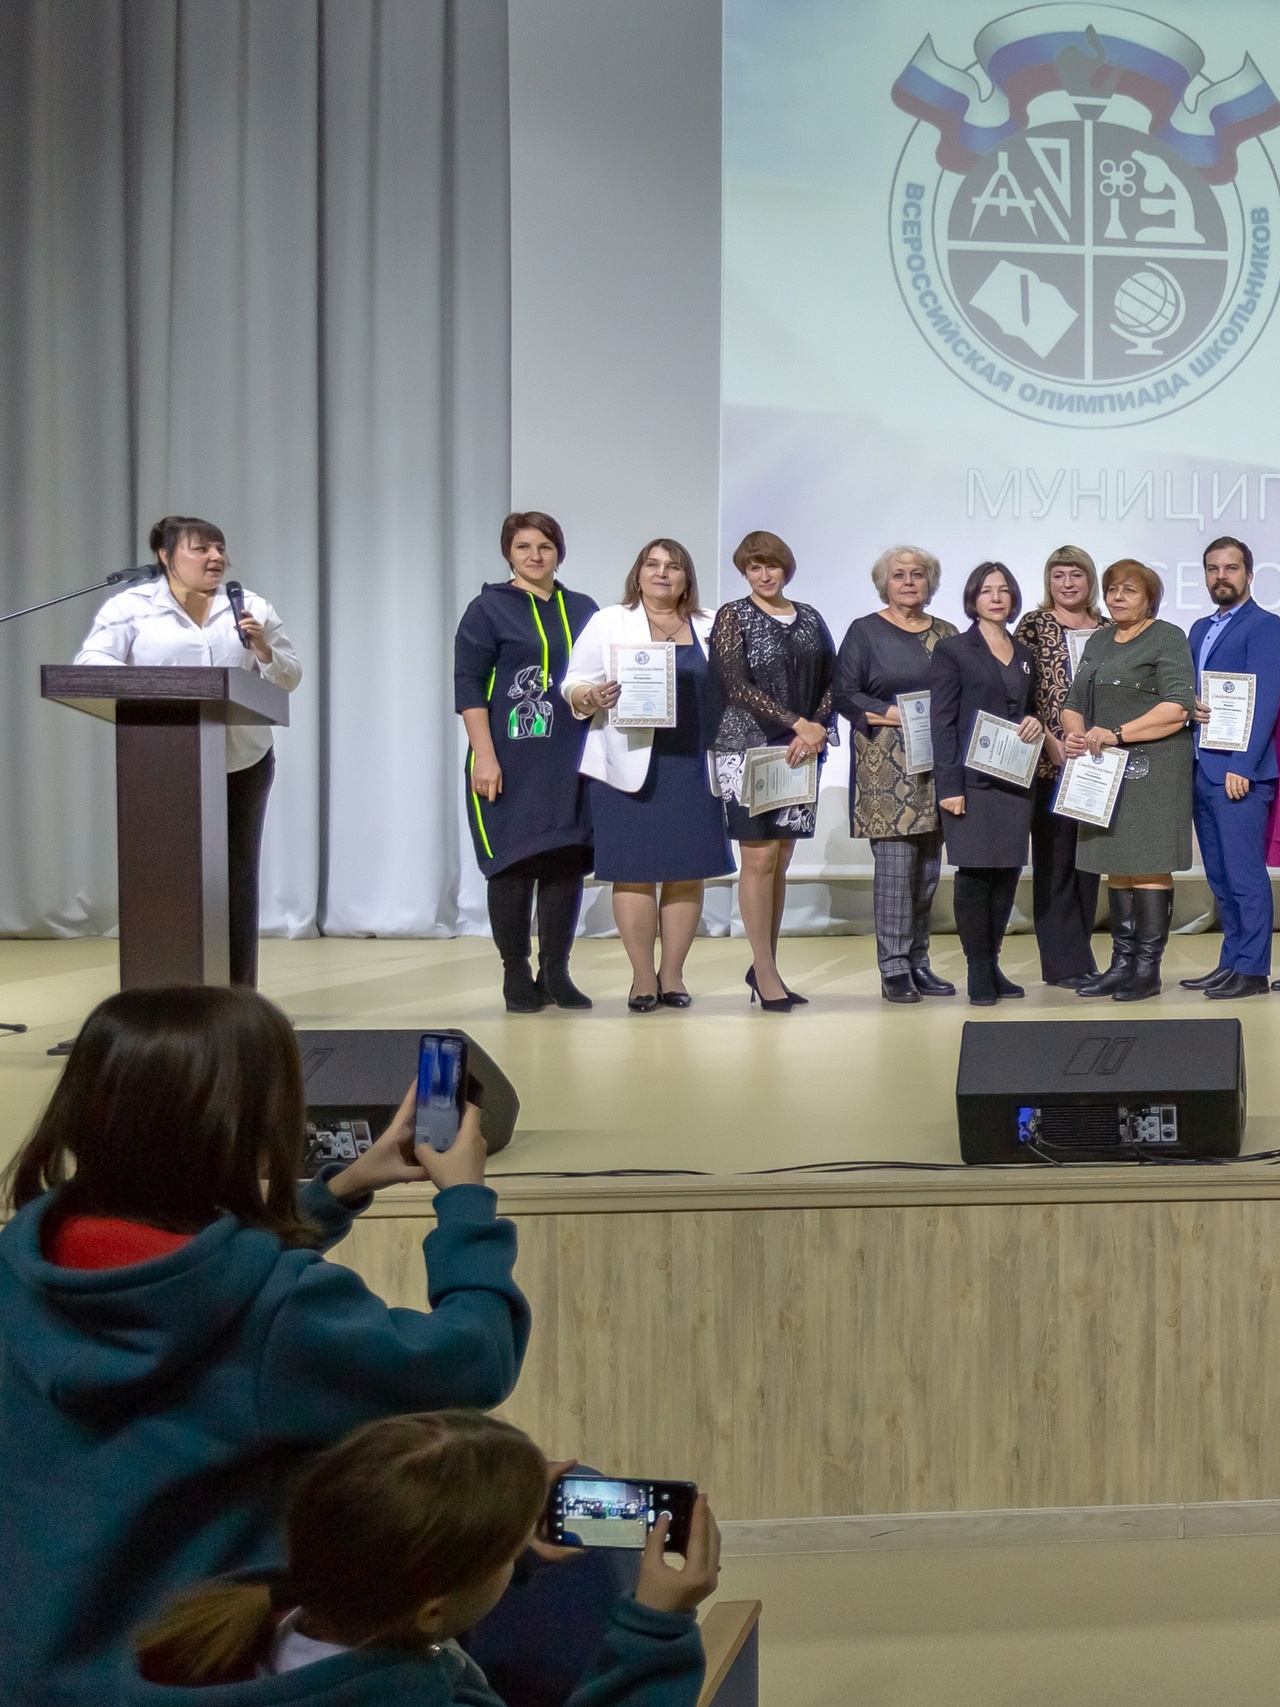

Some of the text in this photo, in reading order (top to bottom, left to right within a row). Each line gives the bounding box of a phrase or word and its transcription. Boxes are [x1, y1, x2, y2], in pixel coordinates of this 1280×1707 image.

[901, 181, 1271, 413] ВСЕРОССИЙСКАЯ ОЛИМПИАДА ШКОЛЬНИКОВ
